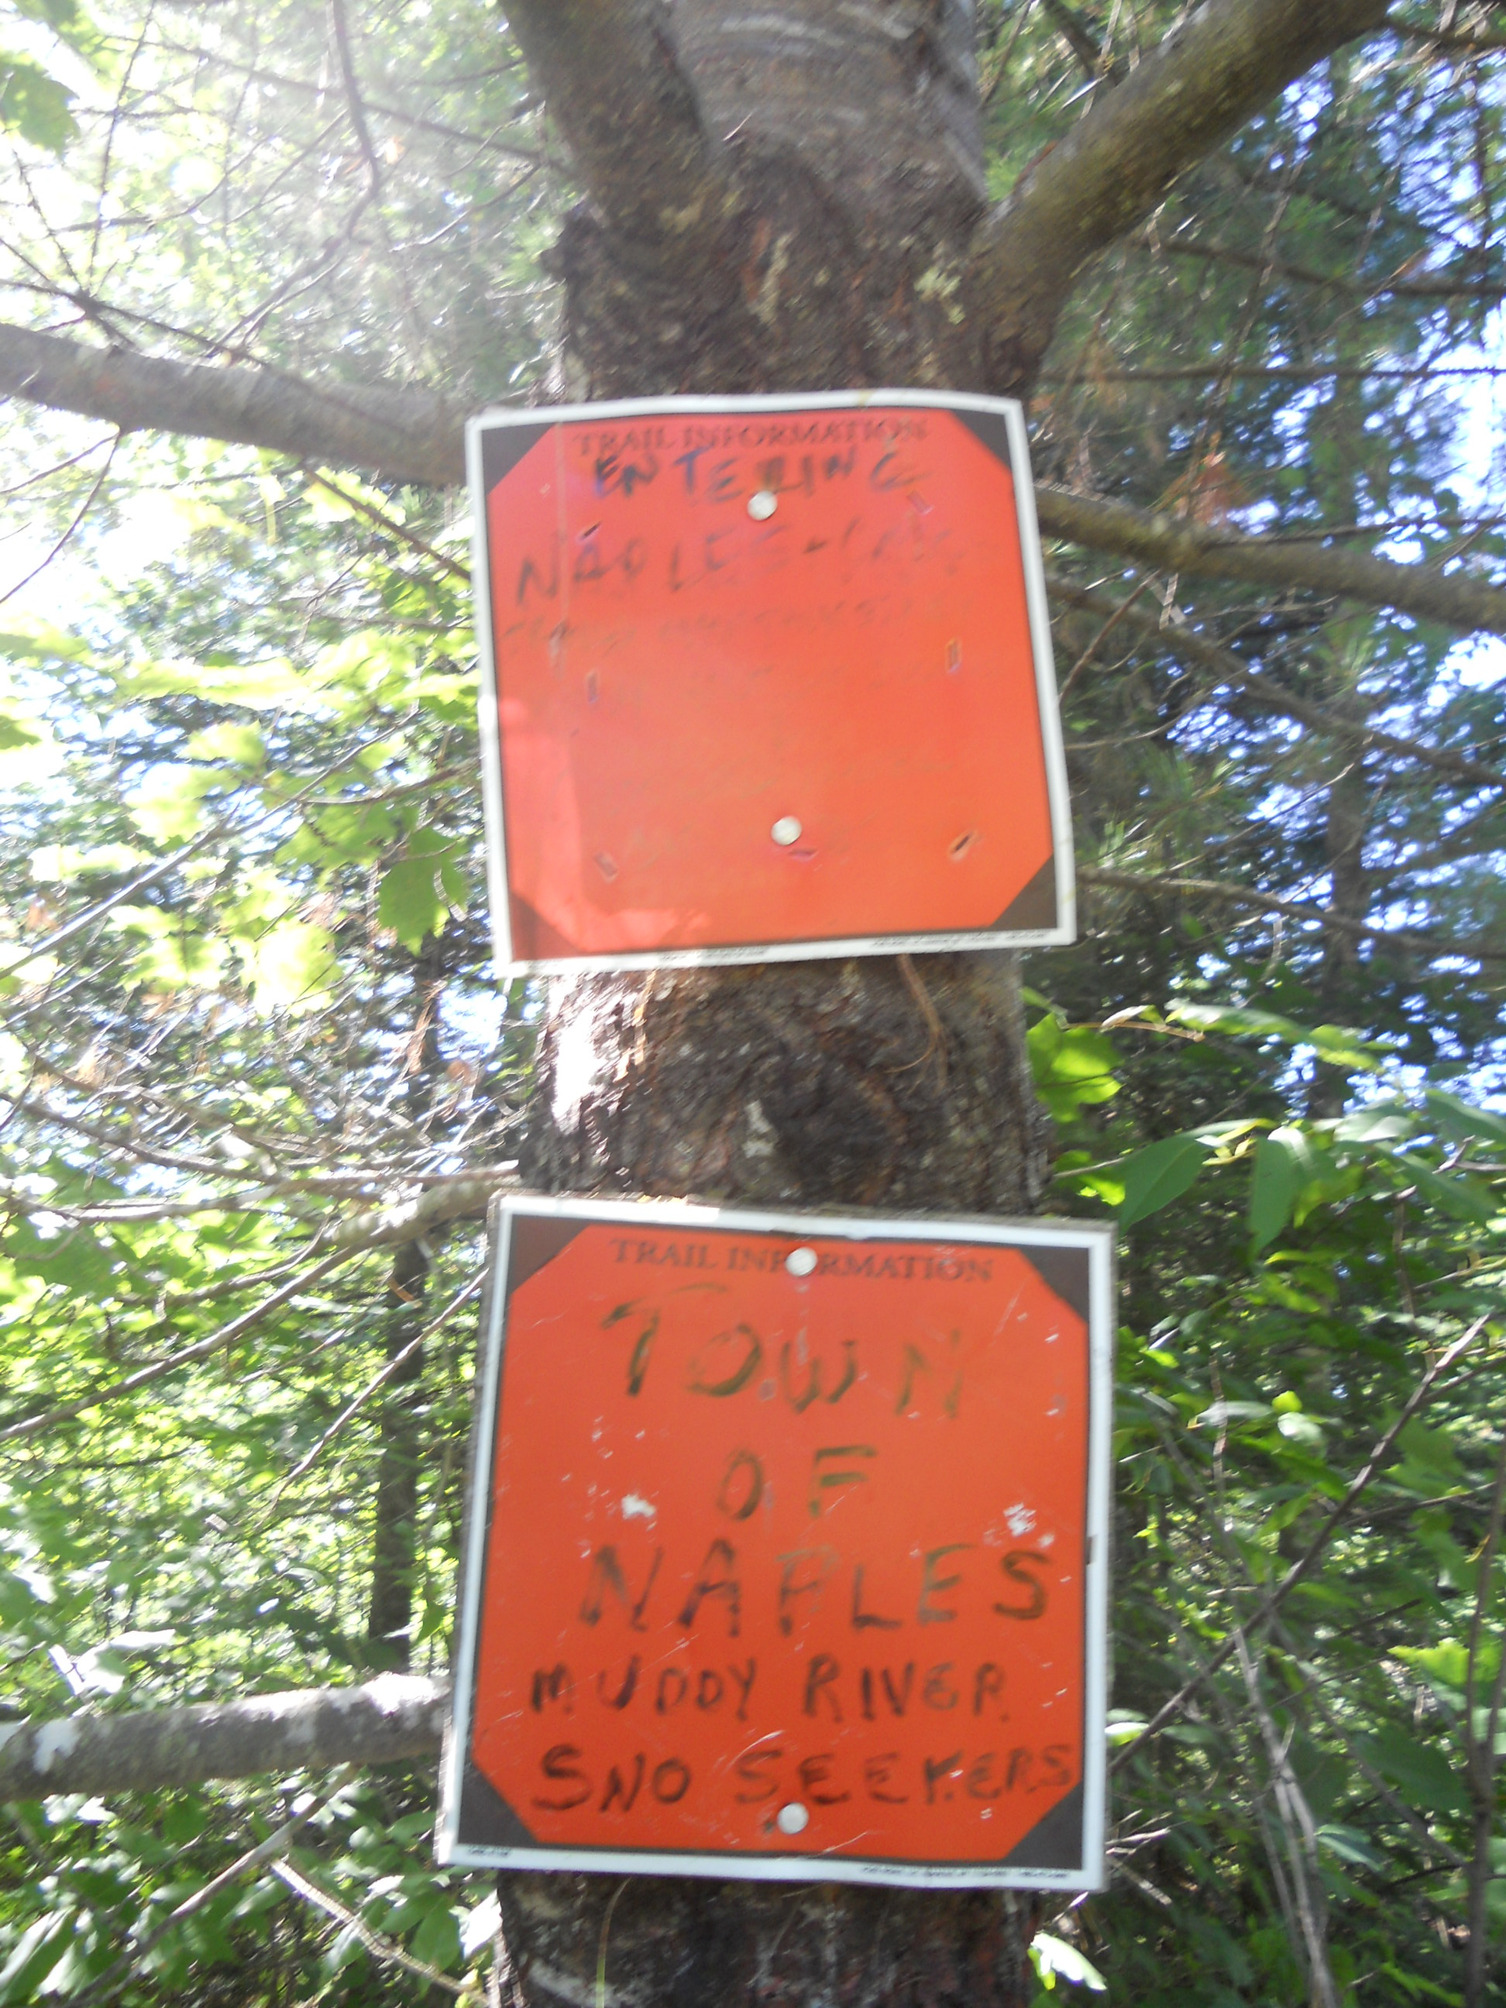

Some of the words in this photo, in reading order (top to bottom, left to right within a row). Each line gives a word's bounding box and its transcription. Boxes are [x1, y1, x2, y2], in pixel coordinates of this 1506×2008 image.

[575, 426, 676, 456] TRAIL
[684, 417, 928, 449] INFORMATION
[611, 1239, 717, 1269] TRAIL
[727, 1246, 993, 1282] INFRMATION
[602, 1282, 964, 1419] TOWN
[717, 1444, 877, 1521] OF
[579, 1539, 1054, 1638] NAPLES
[530, 1656, 758, 1721] MUDDY
[530, 1743, 692, 1813] SNO
[733, 1743, 1075, 1806] SEEKERS
